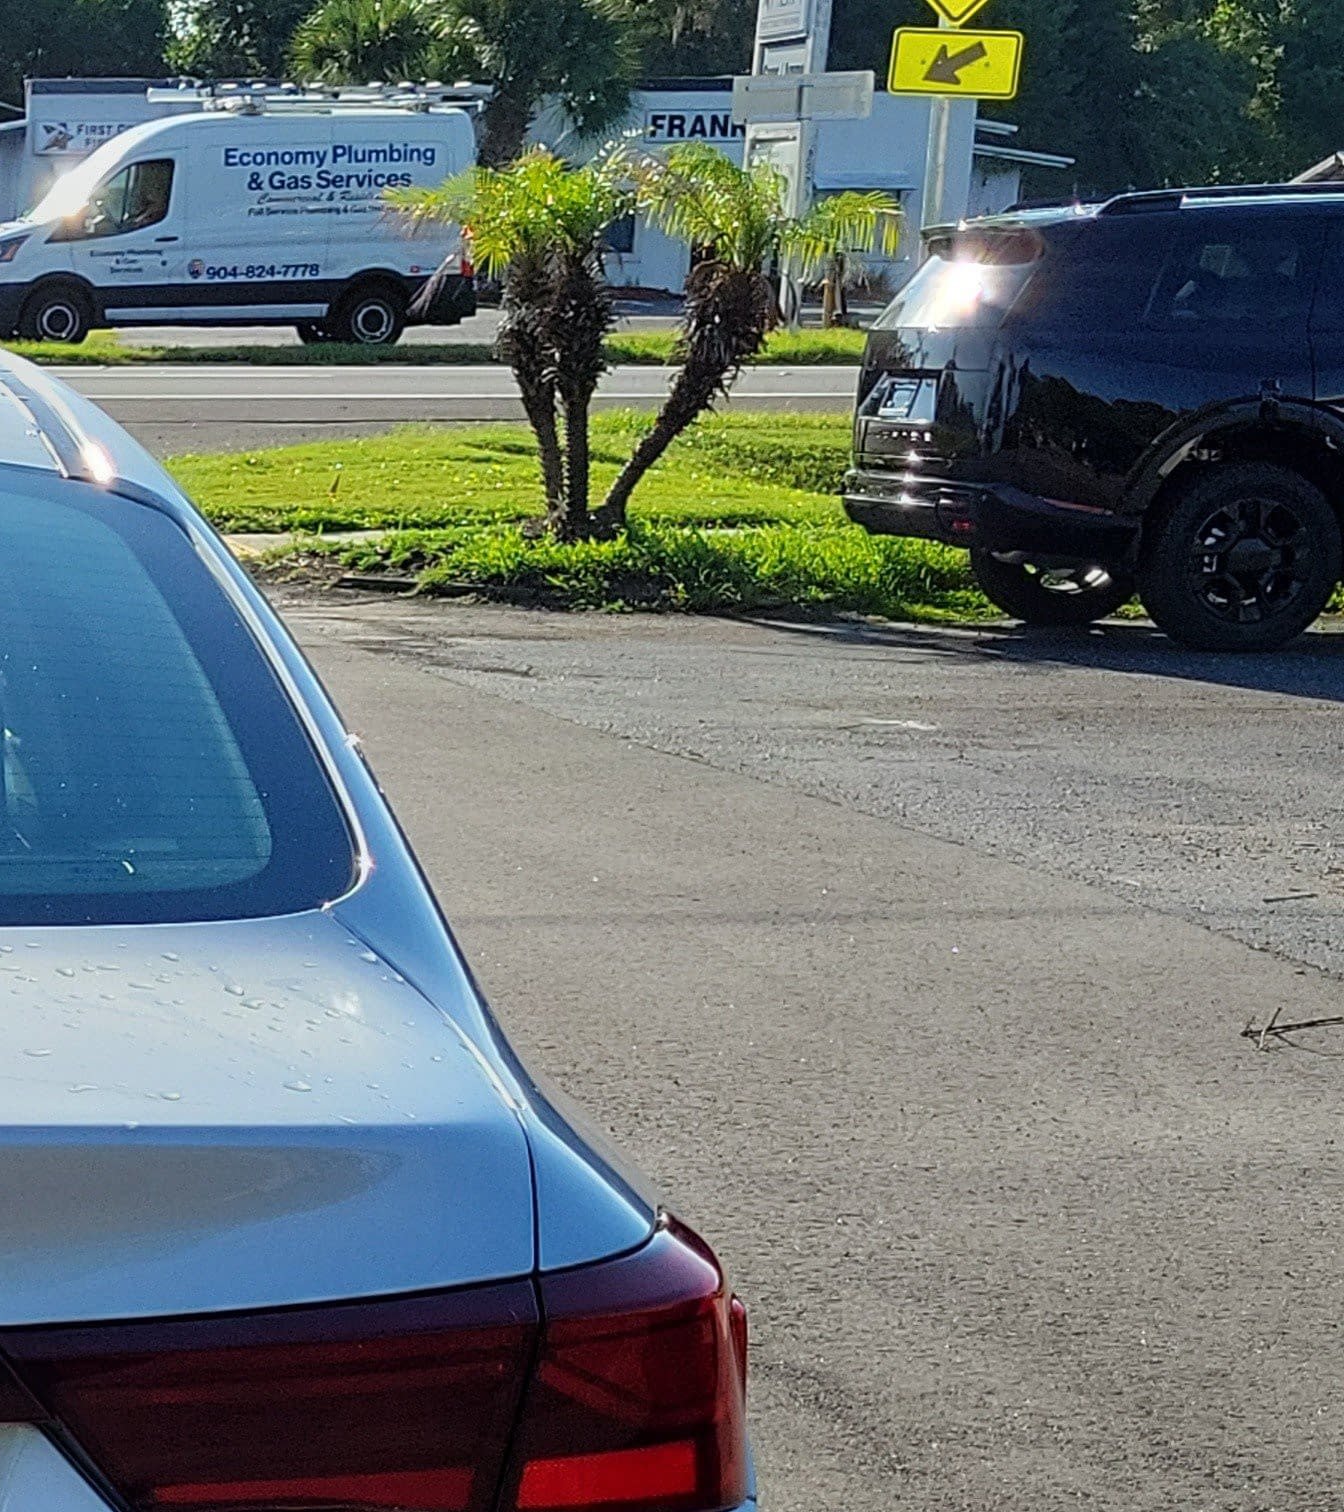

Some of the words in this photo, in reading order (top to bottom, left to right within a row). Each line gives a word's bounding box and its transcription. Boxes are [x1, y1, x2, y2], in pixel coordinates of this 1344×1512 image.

[76, 124, 114, 136] FIRST
[223, 147, 328, 168] Economy
[332, 143, 436, 166] Plumbing
[247, 171, 264, 191] &
[268, 170, 312, 190] Gas
[316, 168, 413, 189] Services
[206, 264, 320, 280] 904-824-7778
